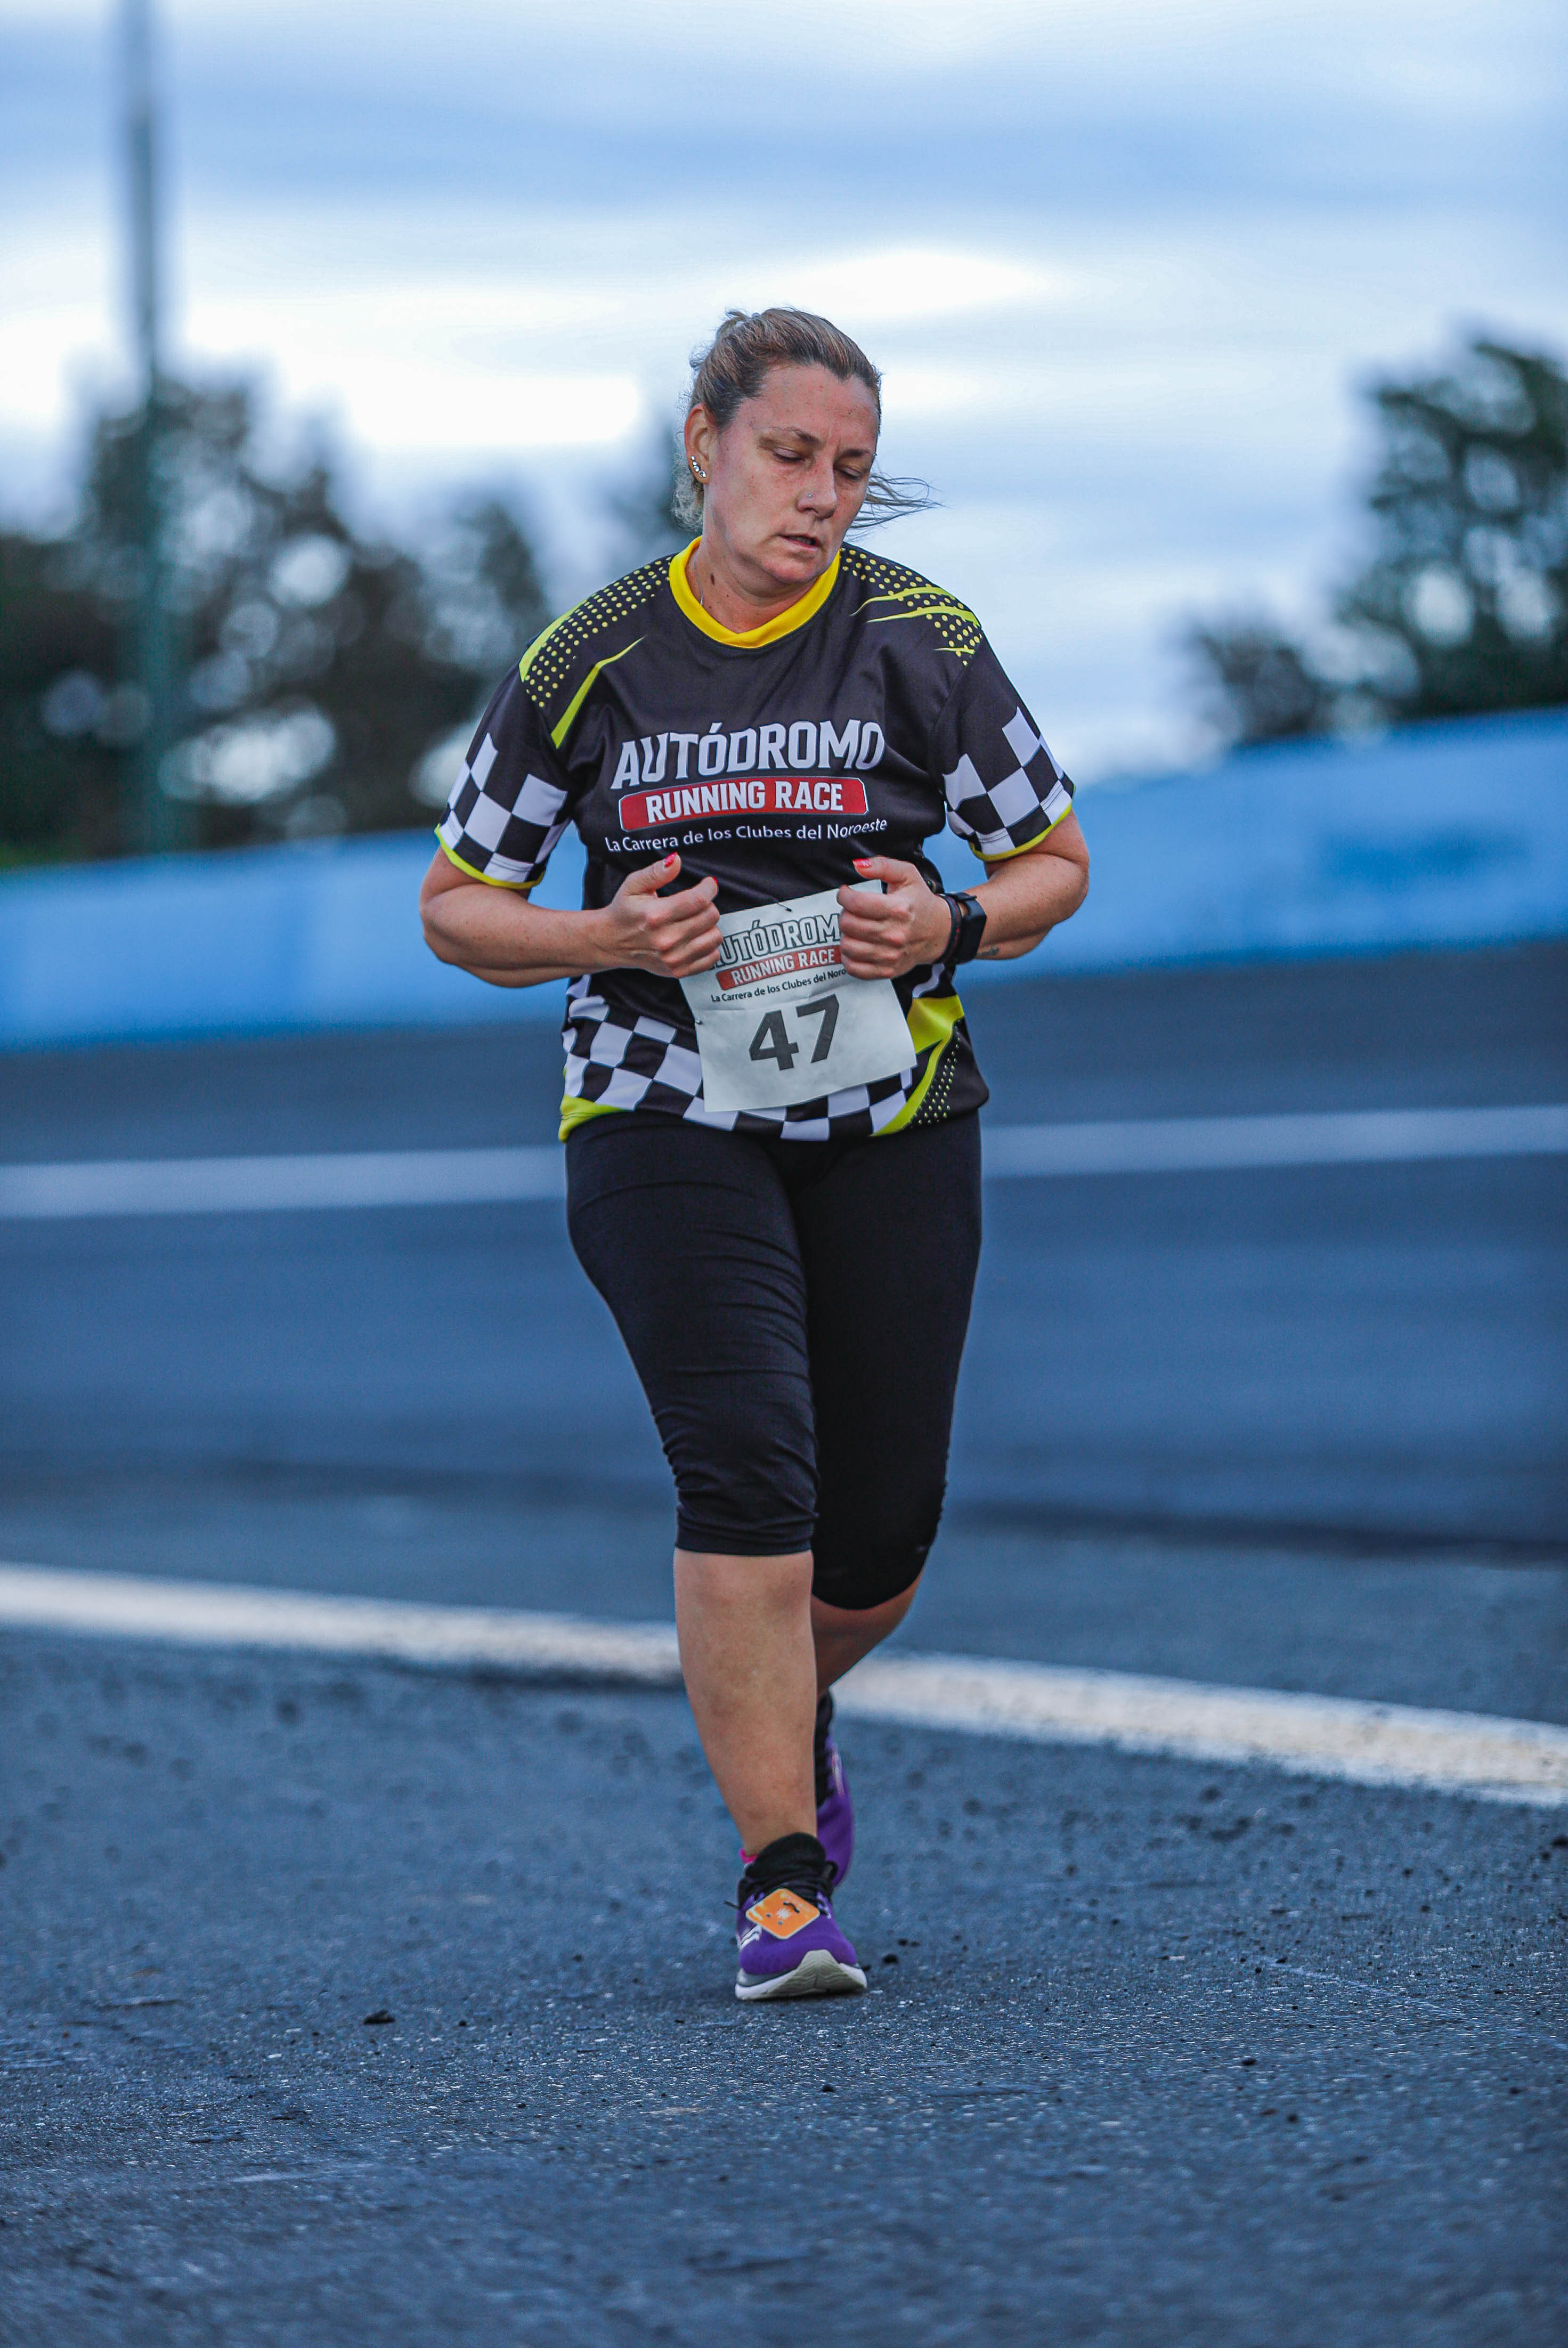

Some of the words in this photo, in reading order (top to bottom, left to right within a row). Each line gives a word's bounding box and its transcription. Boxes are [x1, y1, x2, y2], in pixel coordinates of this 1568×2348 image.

[610, 719, 885, 789] AUTÓDROMO
[645, 781, 766, 824] RUNNING
[775, 781, 843, 812] RACE
[605, 837, 621, 851] La
[622, 836, 679, 851] Carrera
[683, 831, 703, 845] de
[708, 828, 732, 841] los
[736, 825, 791, 839] Clubes
[797, 825, 822, 839] del
[827, 818, 887, 839] Noroeste
[708, 913, 841, 970] UTÓDROM
[721, 992, 752, 1002] Carrera
[754, 988, 765, 996] de
[782, 979, 811, 990] Clubes
[813, 972, 826, 984] del
[827, 969, 846, 979] Noro
[731, 954, 794, 985] RUNNING
[798, 948, 834, 968] RACE
[749, 994, 839, 1071] 47
